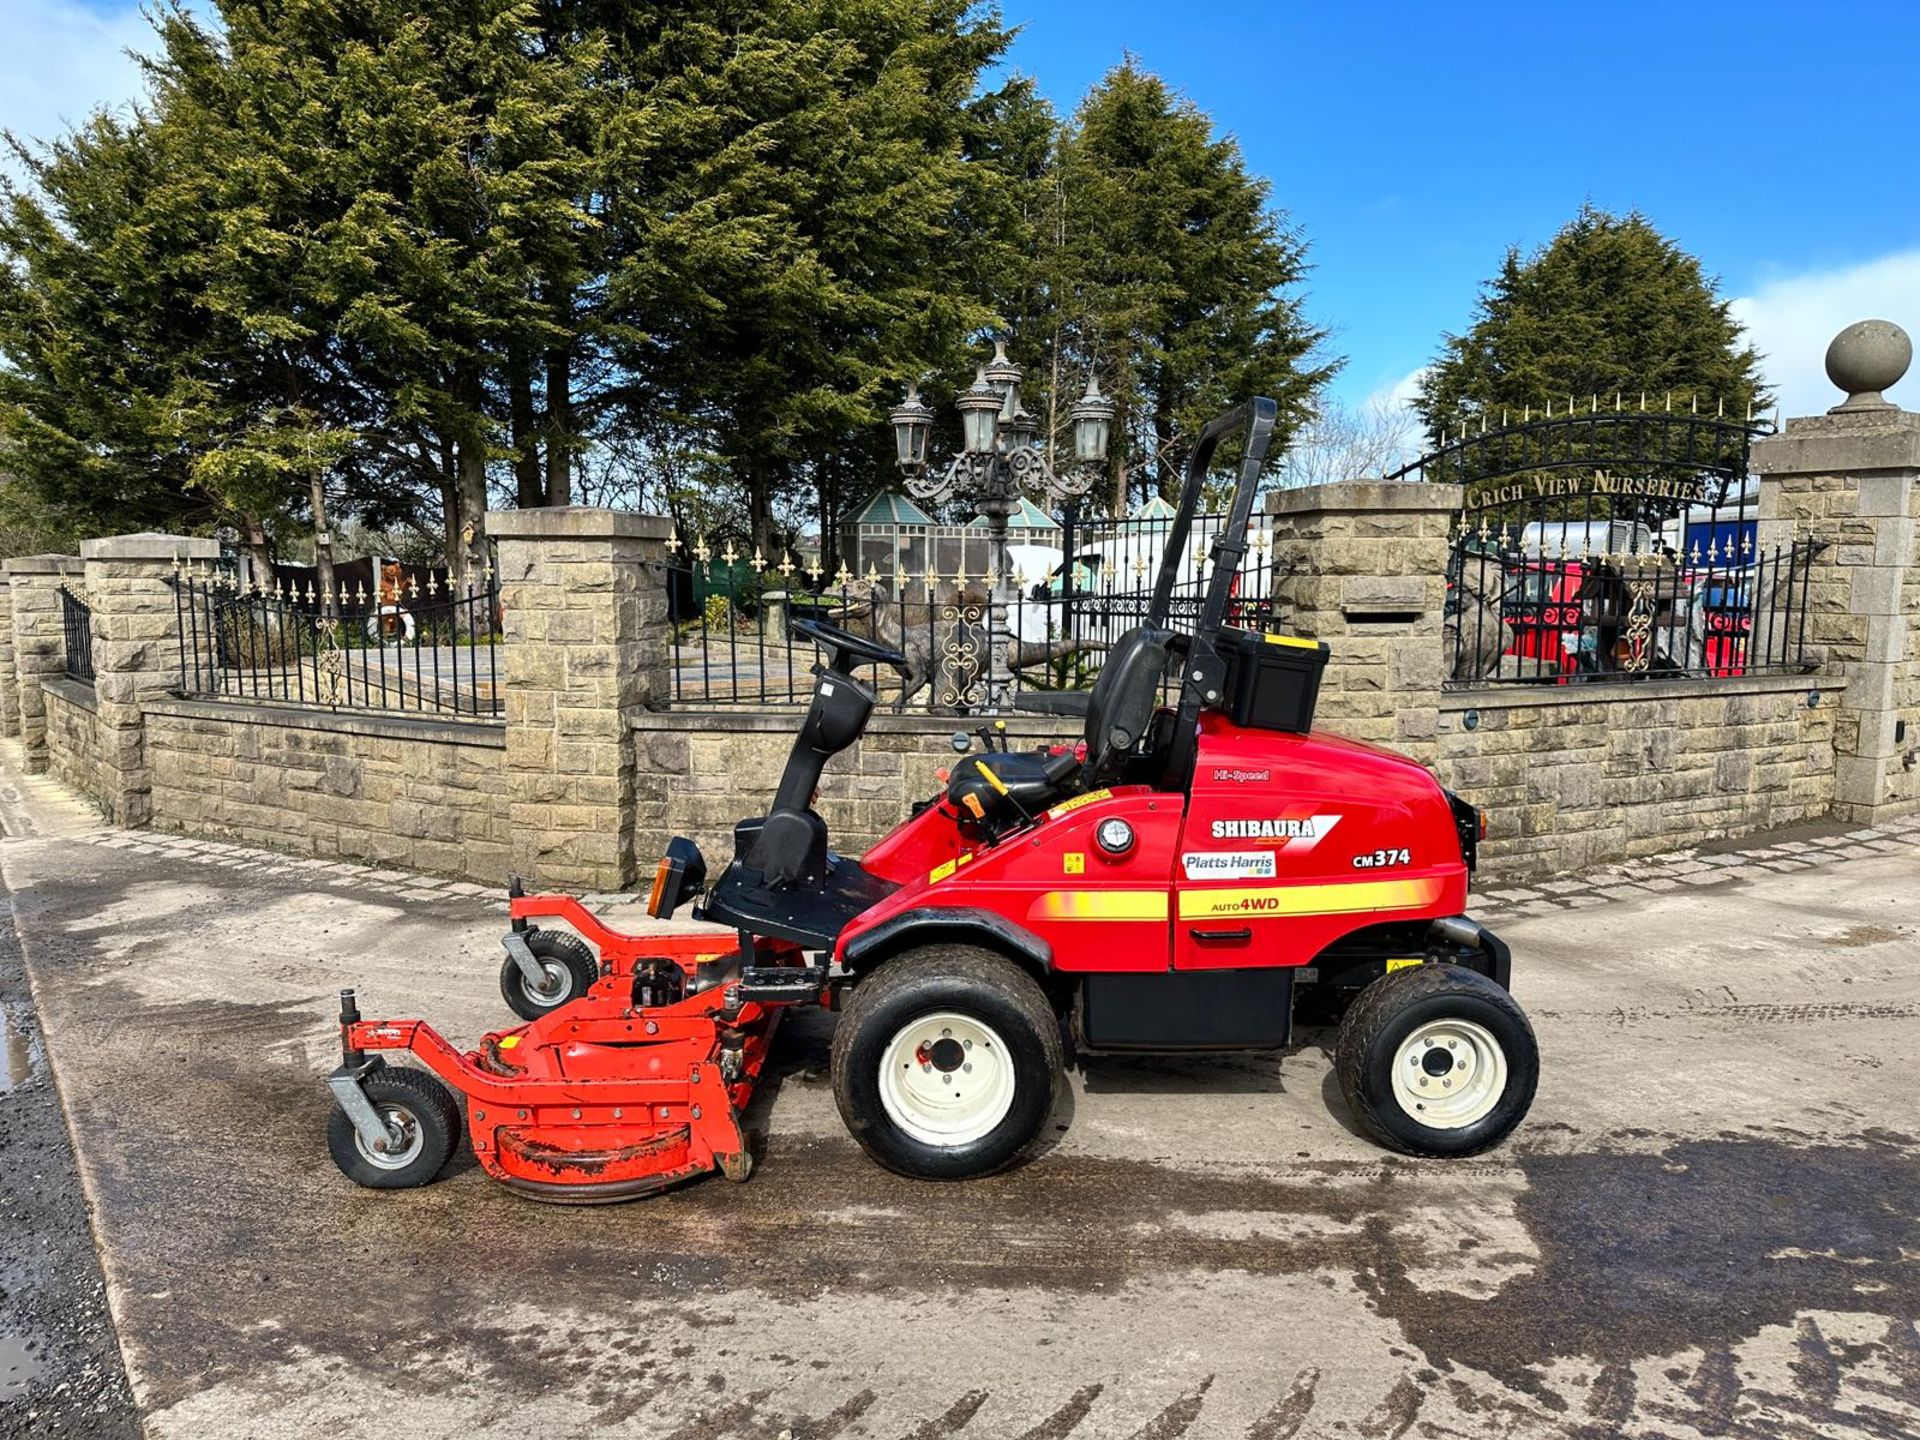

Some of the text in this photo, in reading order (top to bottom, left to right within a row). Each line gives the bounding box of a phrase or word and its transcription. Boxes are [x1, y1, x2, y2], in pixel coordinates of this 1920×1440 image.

[1466, 469, 1706, 510] CRICH VIEW NURSERIES
[1213, 769, 1270, 783] Hi-Speed
[1211, 819, 1315, 838] SHIBAURA
[1186, 855, 1273, 869] Platts Harris
